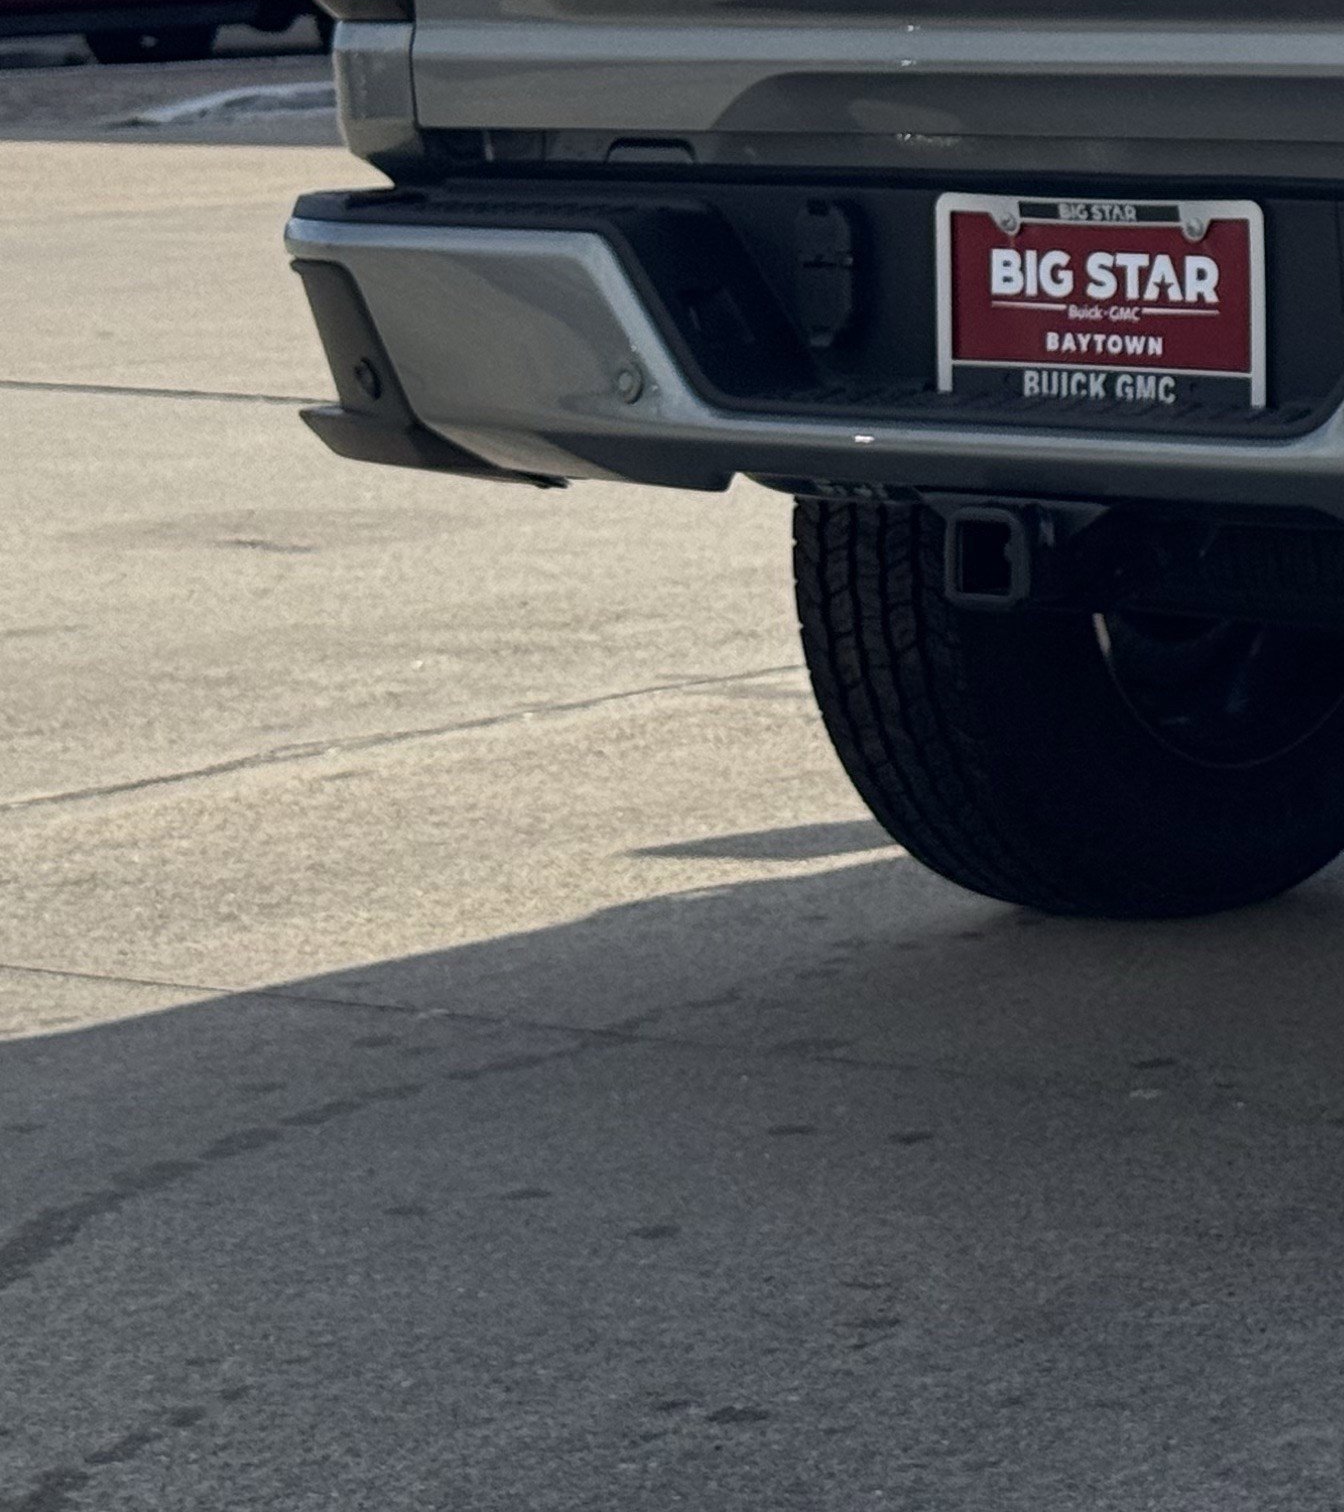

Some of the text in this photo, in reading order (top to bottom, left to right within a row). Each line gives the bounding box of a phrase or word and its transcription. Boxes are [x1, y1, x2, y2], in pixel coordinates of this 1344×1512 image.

[1058, 202, 1137, 222] BIG STAR
[991, 248, 1220, 303] BIG STAR
[1046, 331, 1163, 356] BAYTOWN
[1023, 370, 1177, 405] BUICK GMC
